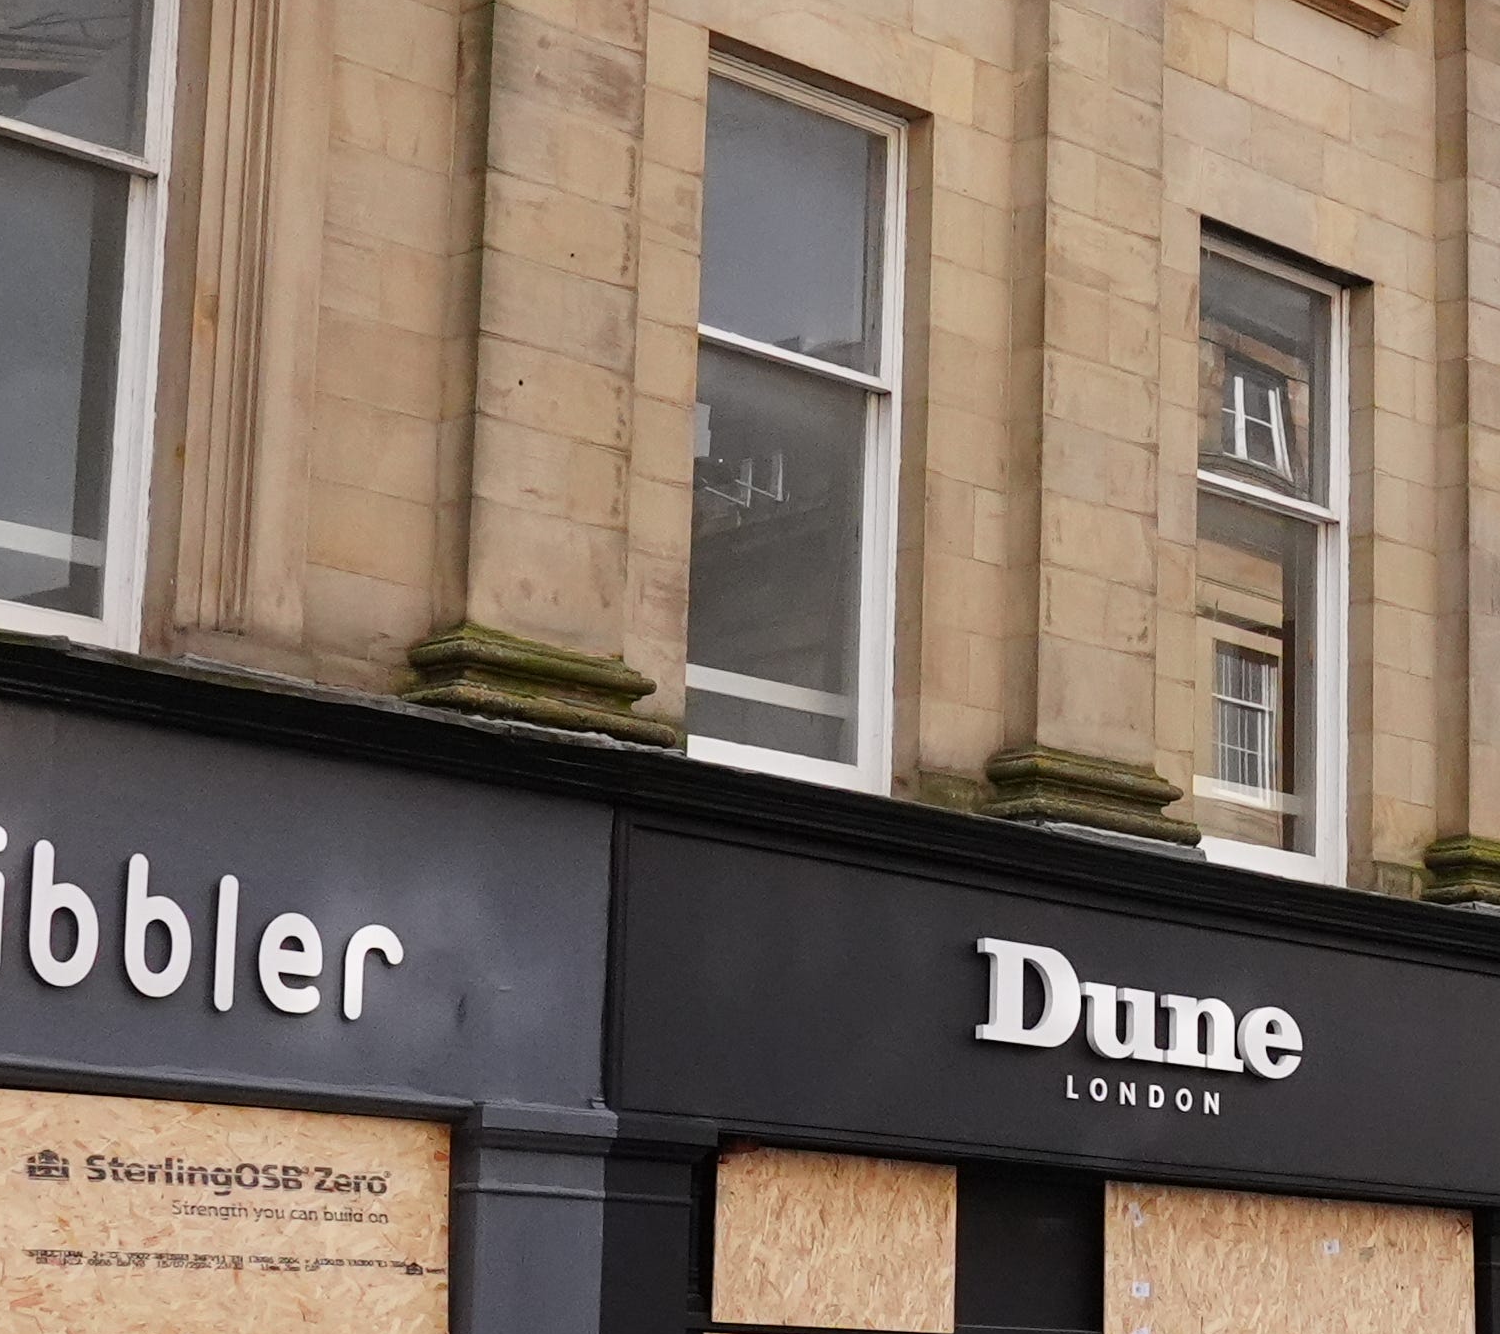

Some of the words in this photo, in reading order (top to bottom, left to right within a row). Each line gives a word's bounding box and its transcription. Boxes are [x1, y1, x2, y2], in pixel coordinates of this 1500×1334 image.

[975, 937, 1303, 1080] Dune
[1066, 1074, 1221, 1115] LONDON
[172, 1199, 249, 1221] Strength
[255, 1206, 285, 1223] you
[291, 1208, 318, 1222] can
[323, 1206, 364, 1222] build
[368, 1211, 389, 1224] on
